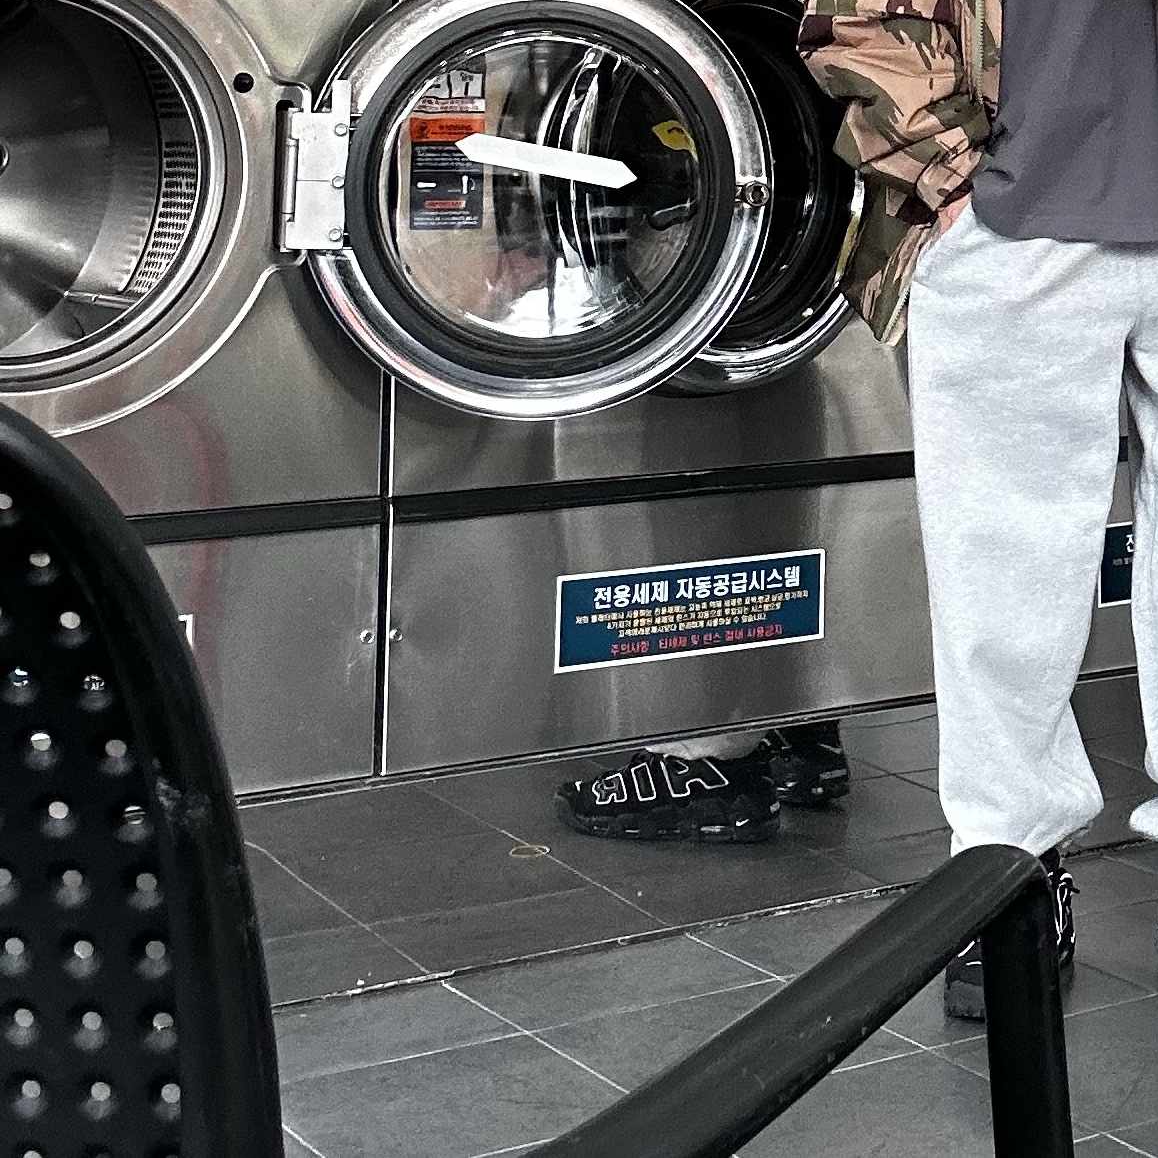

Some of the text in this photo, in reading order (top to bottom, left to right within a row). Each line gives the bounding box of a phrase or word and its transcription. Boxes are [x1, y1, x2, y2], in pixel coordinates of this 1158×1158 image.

[593, 580, 669, 610] 전용세제
[675, 565, 800, 600] 자동공급시스템
[610, 641, 650, 657] 주의사항
